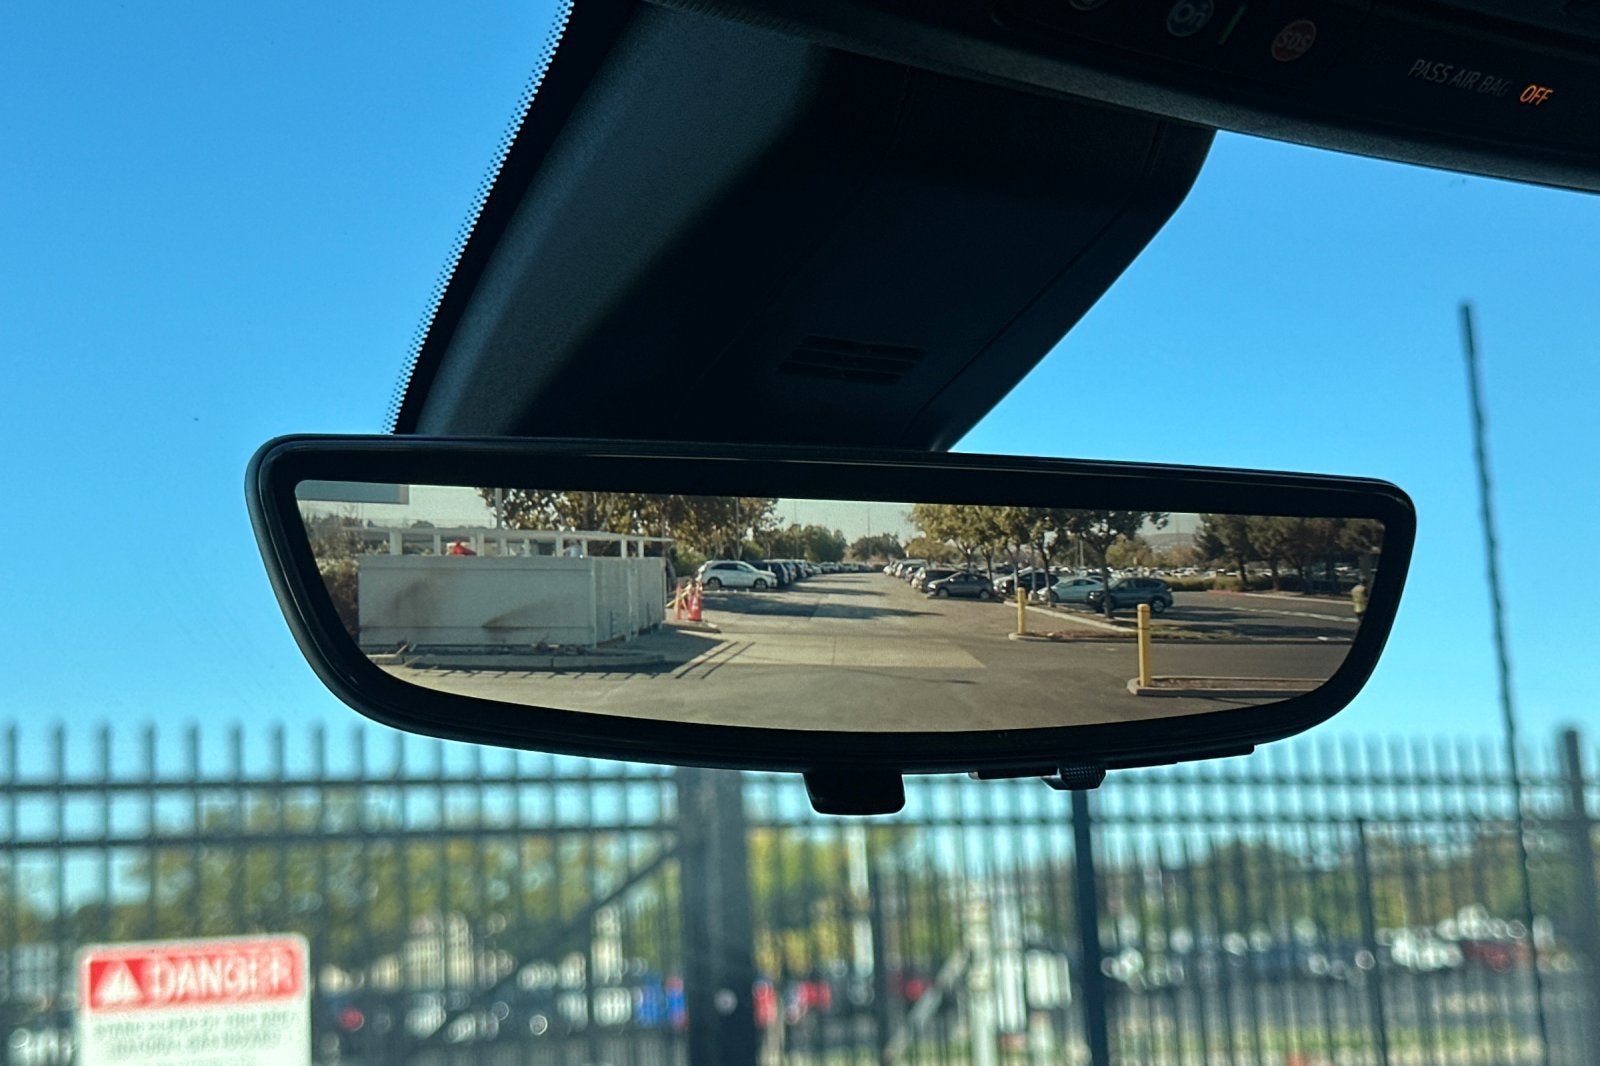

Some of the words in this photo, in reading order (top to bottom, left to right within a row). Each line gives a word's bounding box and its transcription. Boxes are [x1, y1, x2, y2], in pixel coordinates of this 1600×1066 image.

[1277, 31, 1313, 52] SOS
[1408, 59, 1453, 83] PASS
[1449, 70, 1482, 90] AIR
[1477, 75, 1512, 97] BAG
[1519, 84, 1554, 106] OFF
